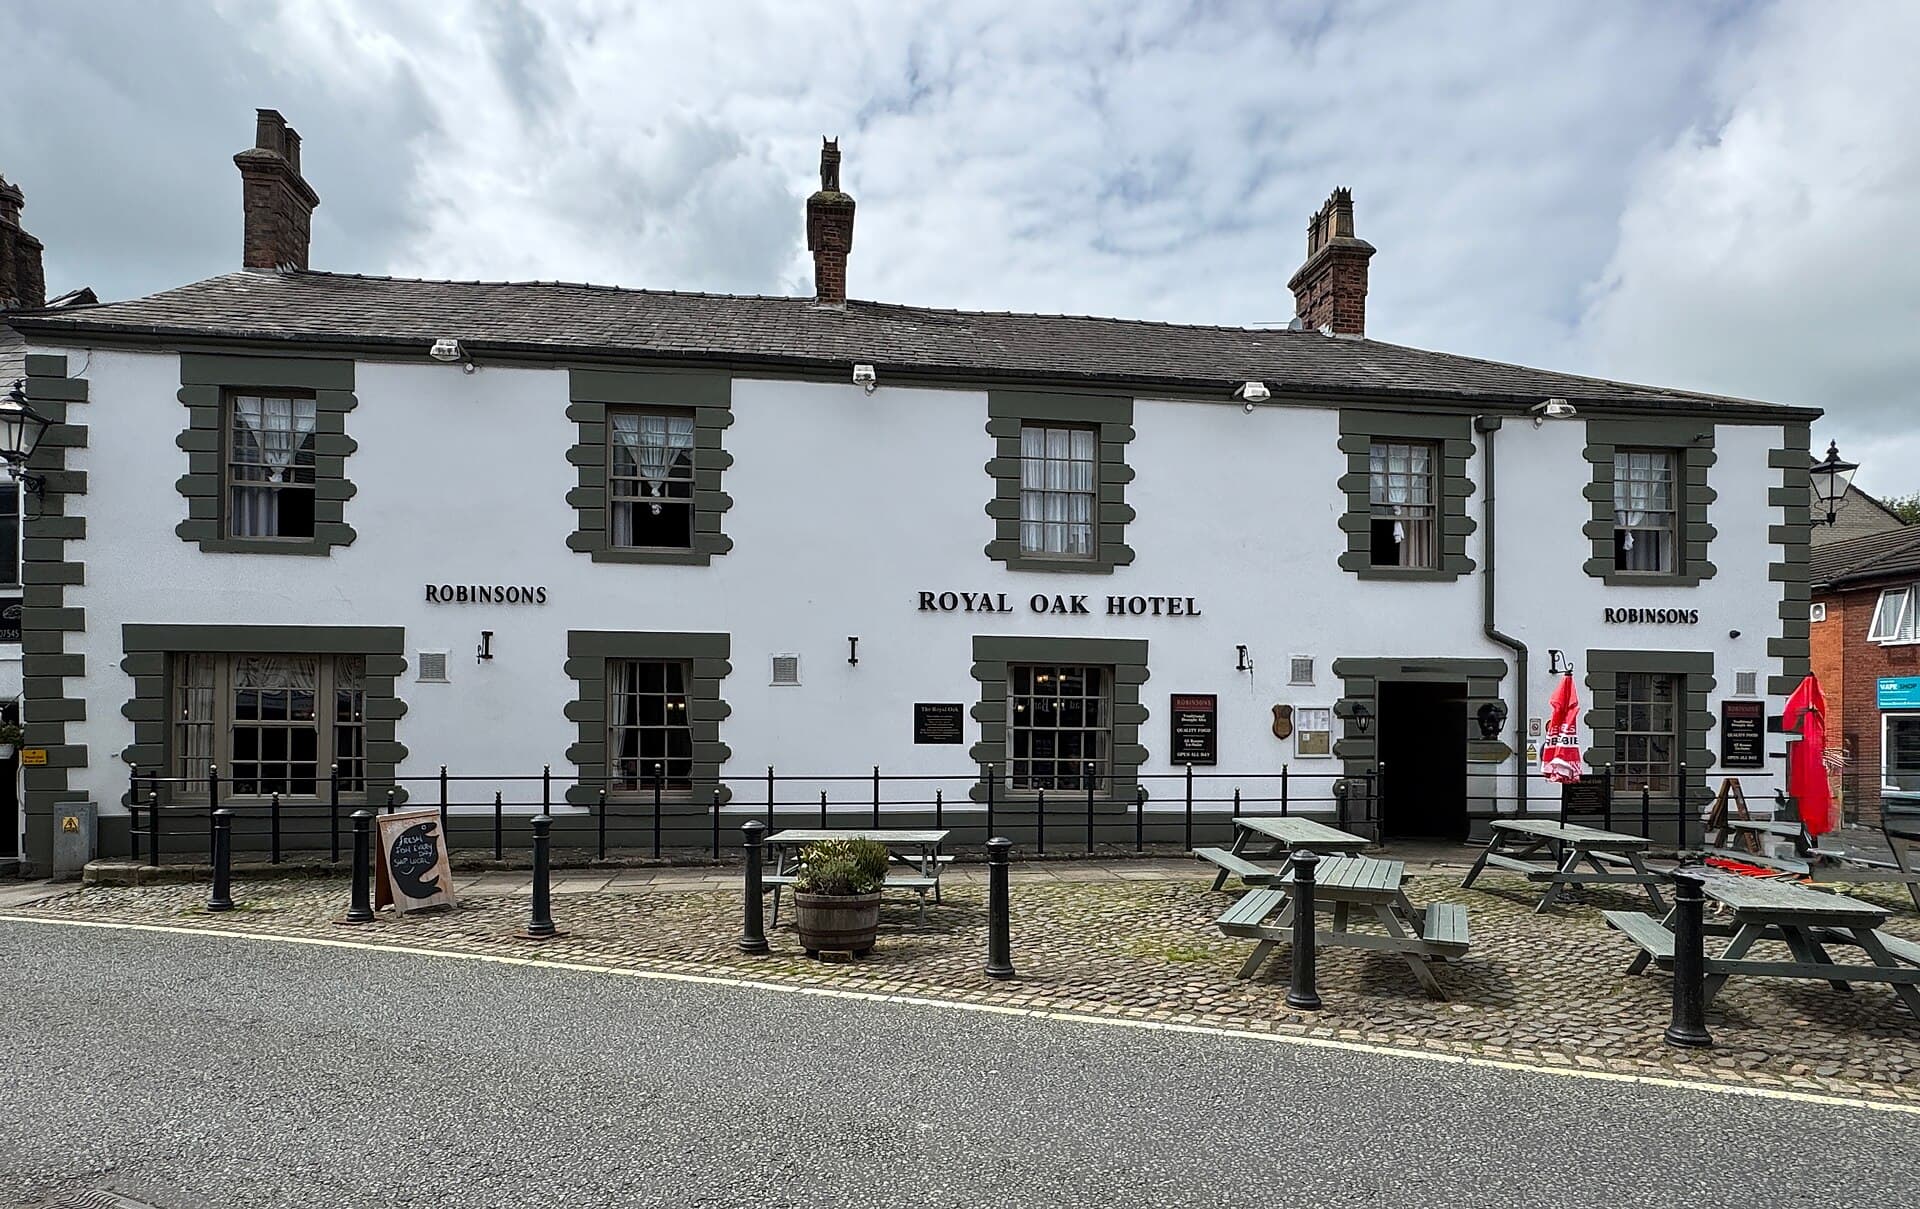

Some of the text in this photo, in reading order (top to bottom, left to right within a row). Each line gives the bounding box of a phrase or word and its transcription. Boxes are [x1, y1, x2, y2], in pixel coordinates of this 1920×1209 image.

[425, 584, 546, 604] ROBINSONS
[918, 591, 1202, 616] ROYAL OAK HOTEL
[1604, 608, 1699, 624] ROBINSONS
